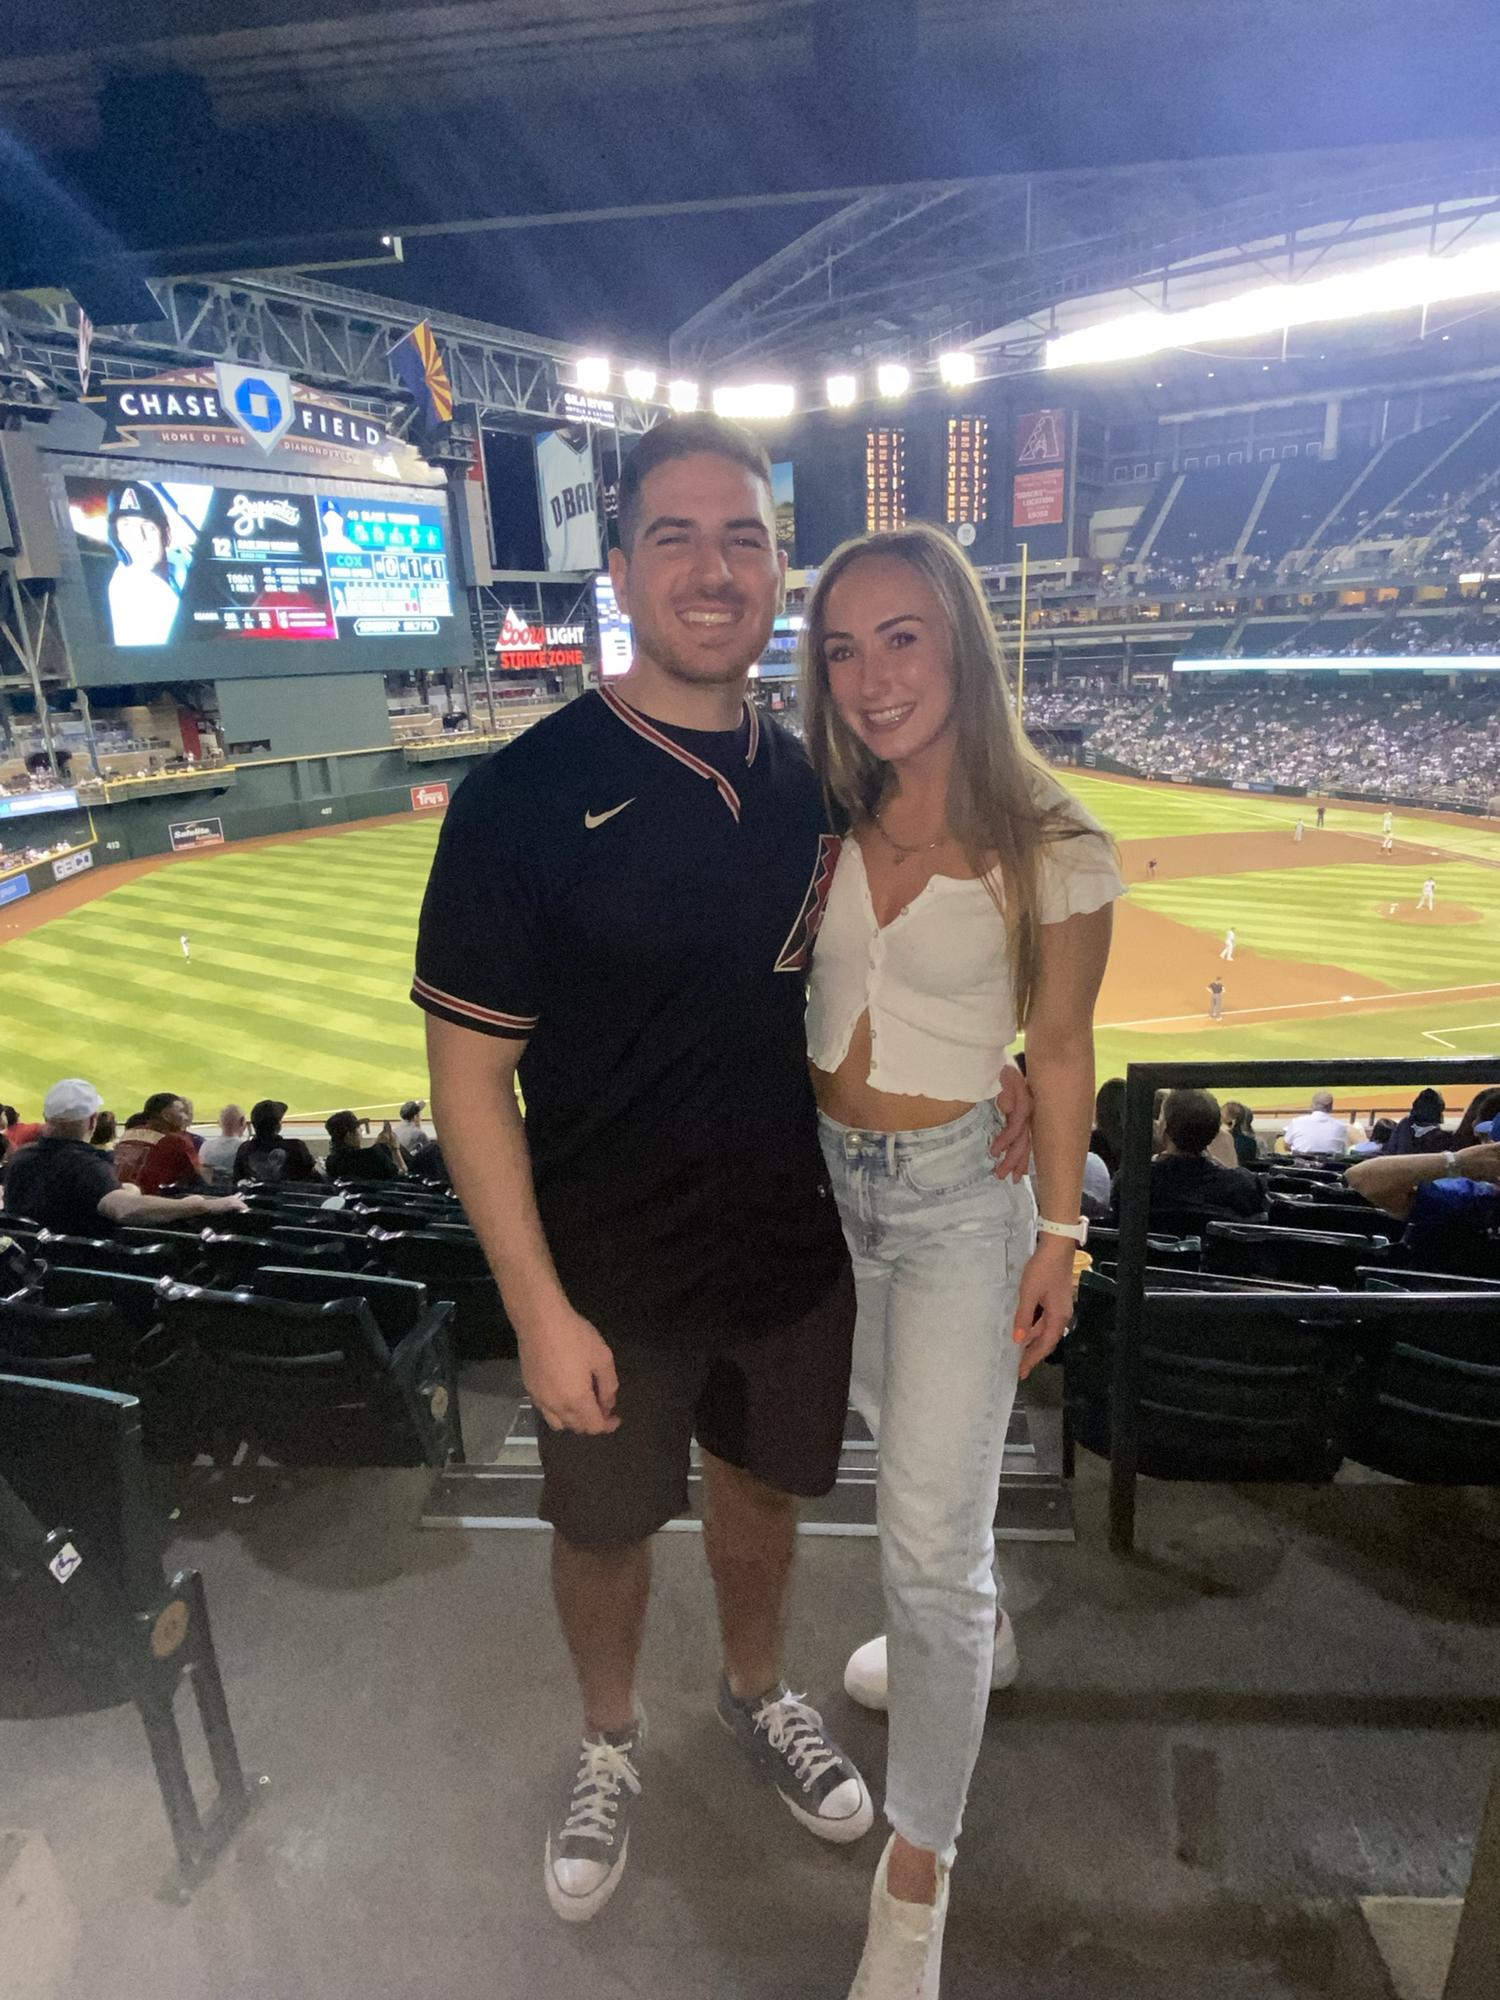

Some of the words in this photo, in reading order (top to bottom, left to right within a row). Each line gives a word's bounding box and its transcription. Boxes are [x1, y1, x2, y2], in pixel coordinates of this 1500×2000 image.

[119, 393, 219, 418] CHASE
[301, 410, 381, 446] FIELD
[161, 432, 195, 443] HOME
[203, 434, 217, 443] OF
[225, 435, 246, 446] THE
[212, 538, 232, 558] 12
[335, 554, 363, 567] COX
[226, 574, 255, 584] TODAY
[499, 620, 545, 646] Coors
[546, 626, 585, 645] LIGHT
[501, 650, 548, 669] STRIKE
[549, 649, 583, 666] ZONE
[106, 841, 120, 850] 413
